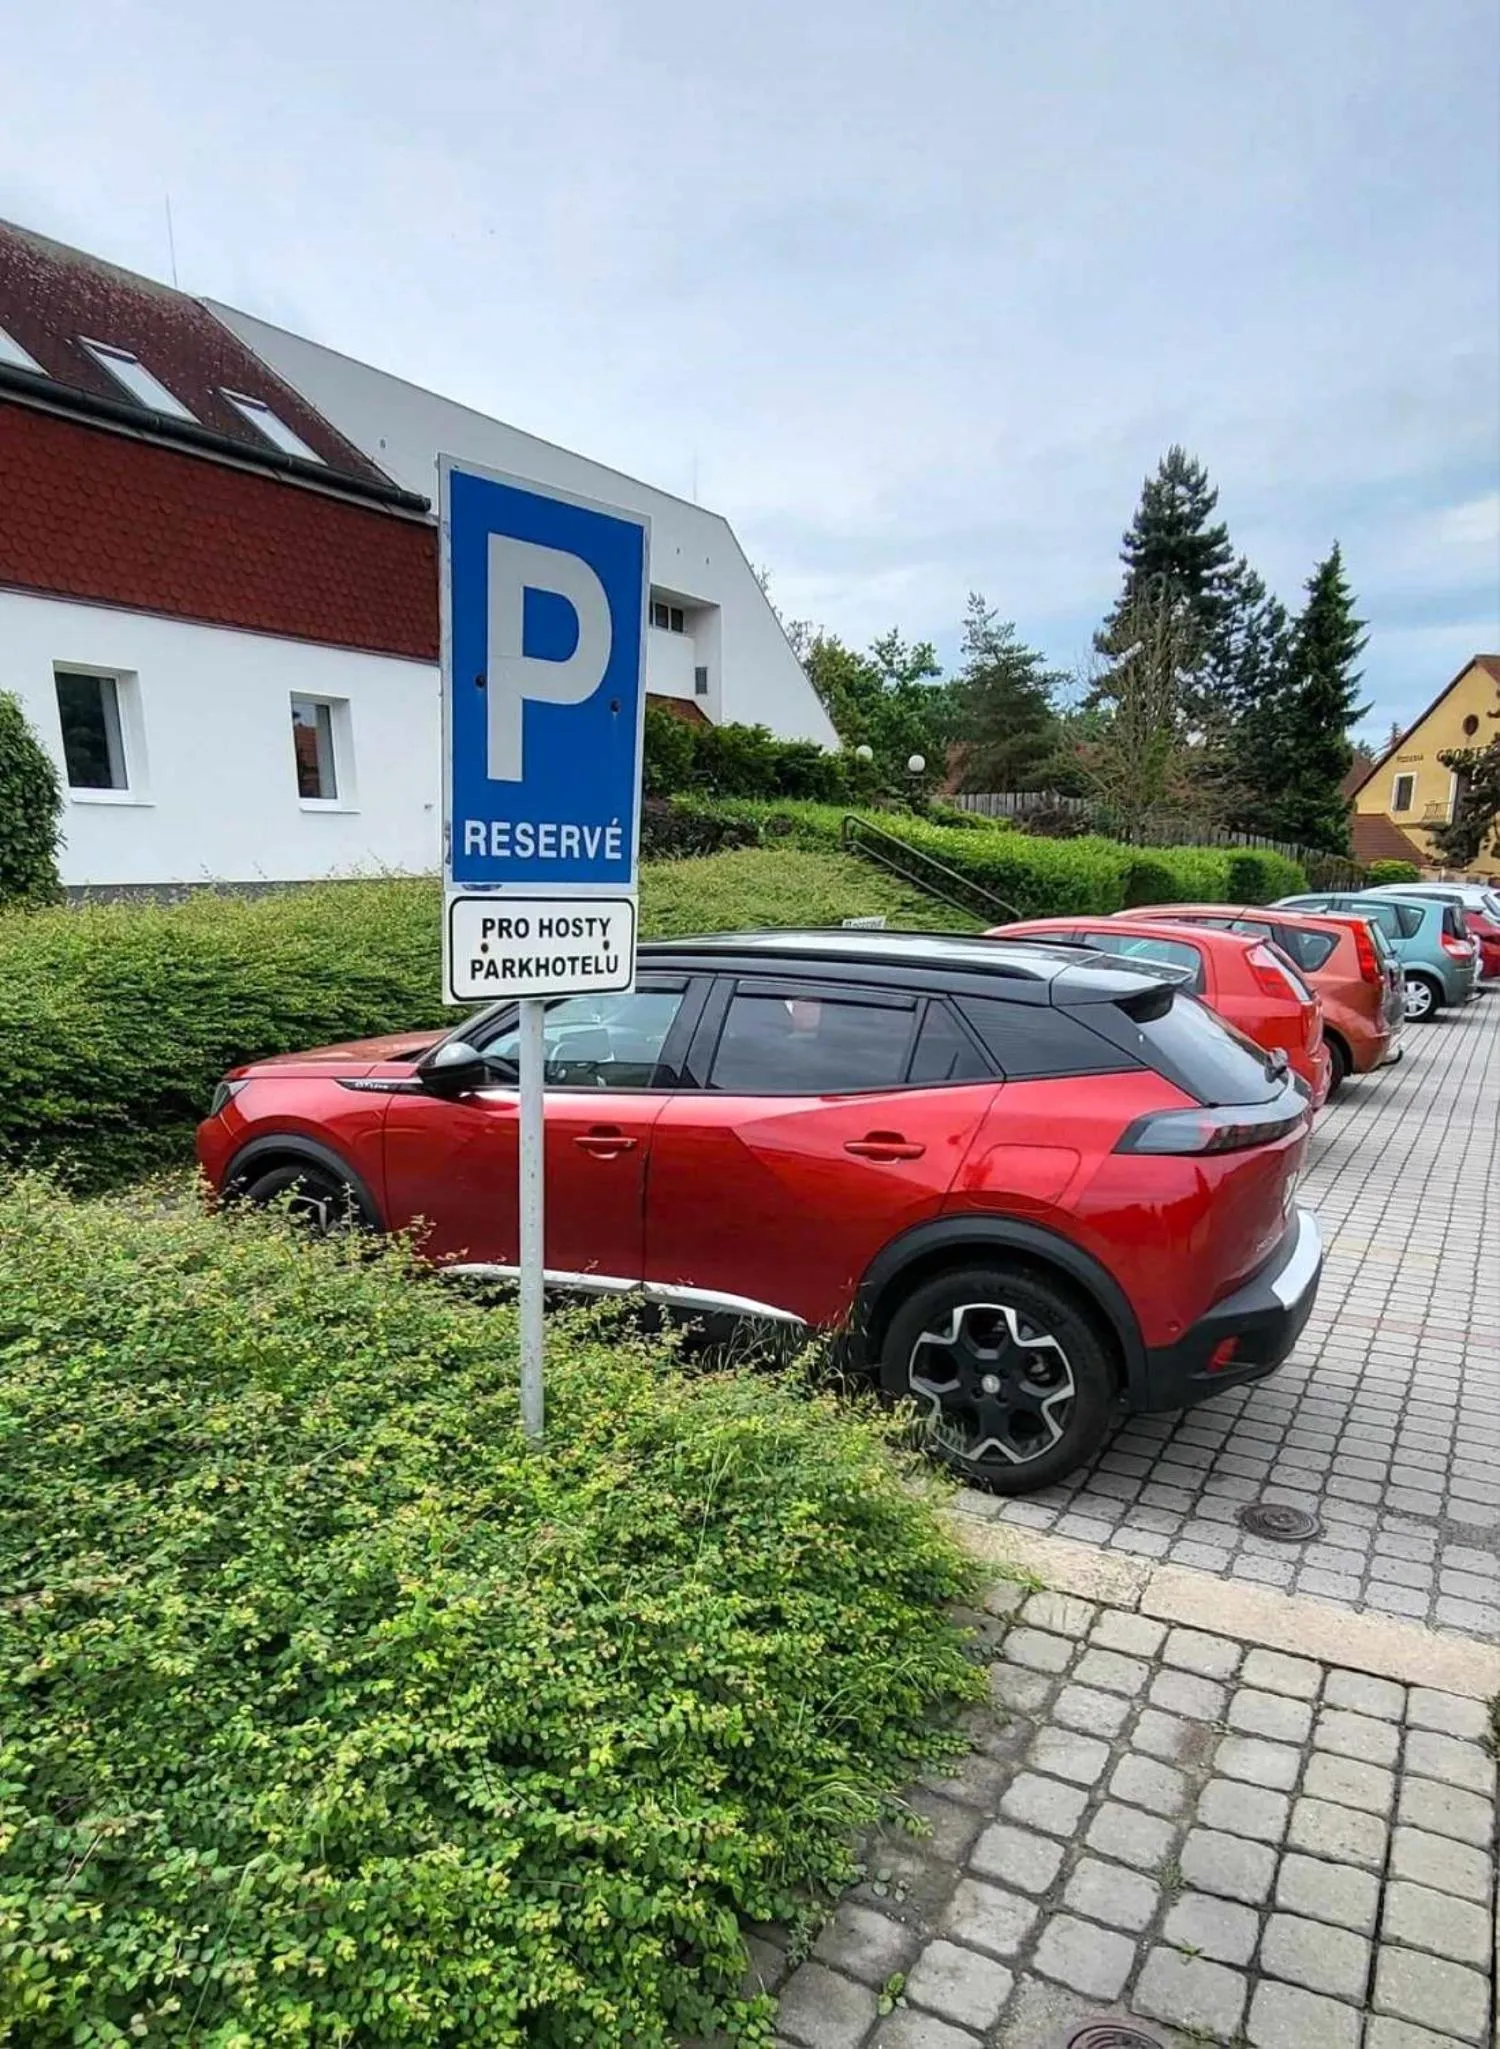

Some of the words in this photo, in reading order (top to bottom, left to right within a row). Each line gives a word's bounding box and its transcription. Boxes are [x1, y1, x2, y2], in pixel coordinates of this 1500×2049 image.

[487, 532, 612, 782] P
[464, 817, 623, 860] RESERVÉ
[481, 917, 530, 939] PRO
[538, 917, 611, 938] HOSTY
[470, 955, 619, 981] PARKHOTELU
